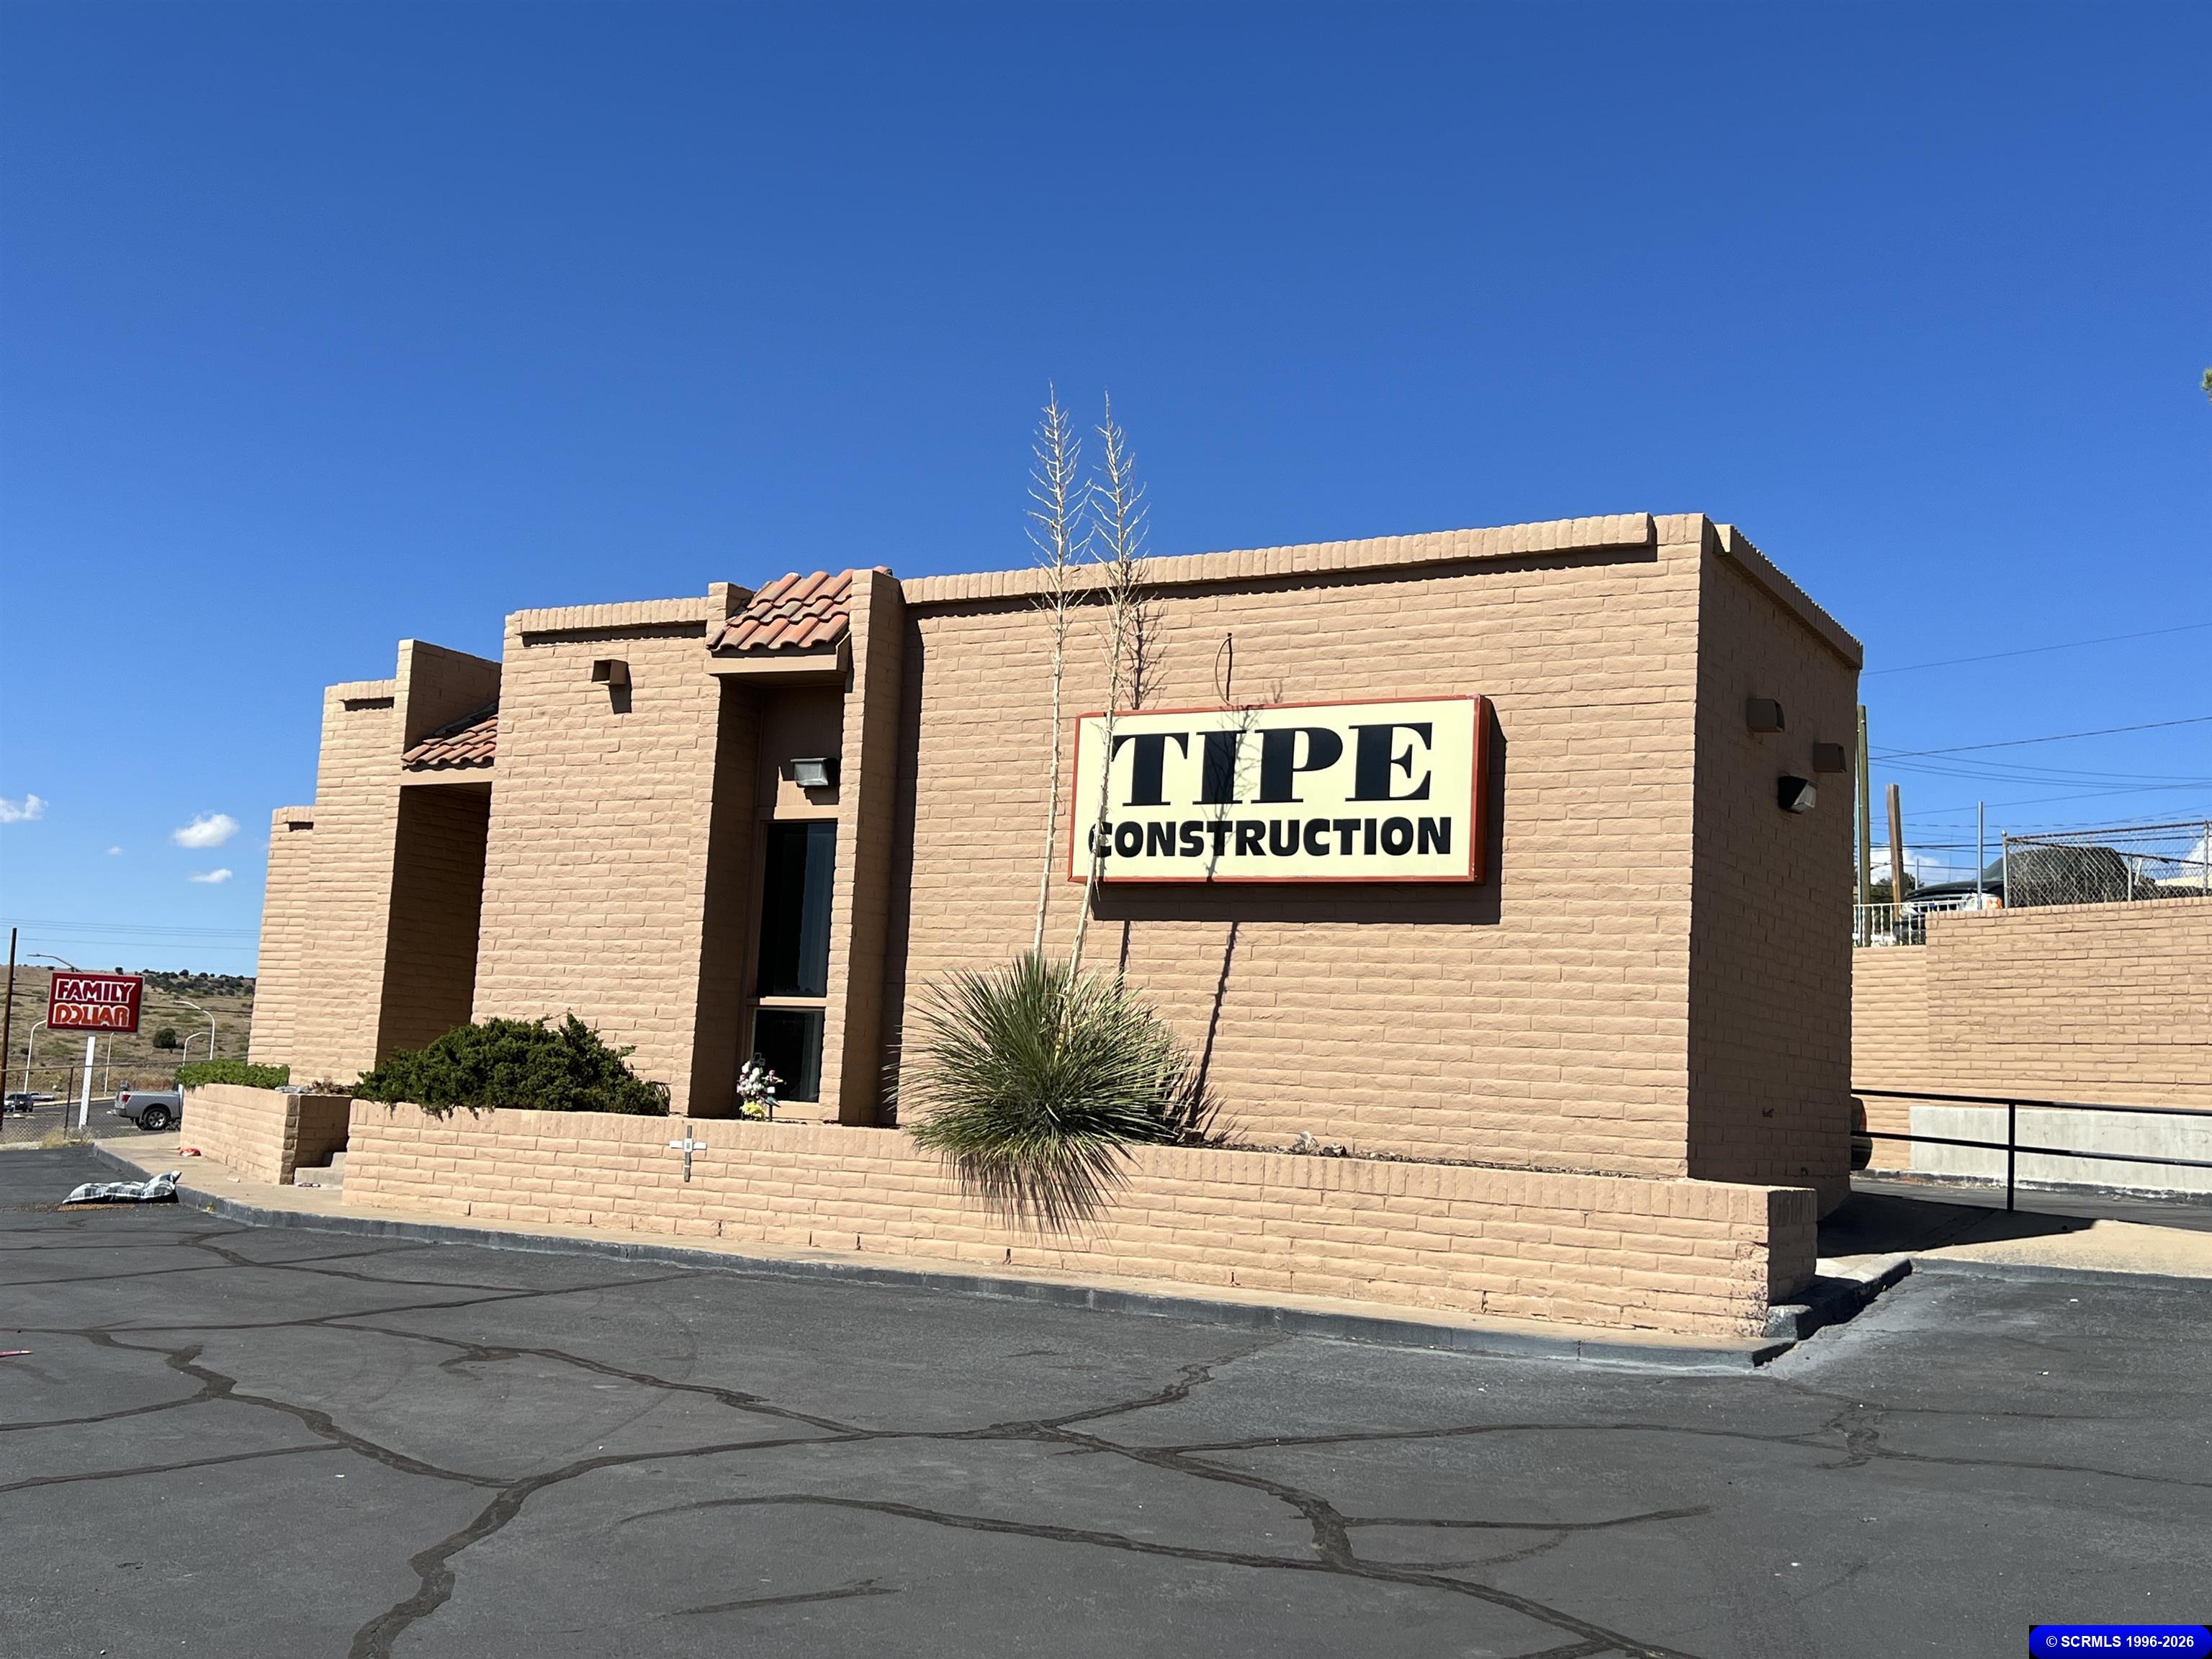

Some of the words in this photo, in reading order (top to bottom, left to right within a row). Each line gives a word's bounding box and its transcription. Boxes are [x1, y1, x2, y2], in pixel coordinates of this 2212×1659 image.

[1110, 721, 1433, 806] TIPE
[1088, 817, 1452, 858] CONSTRUCTION
[55, 979, 136, 1003] FAMILY
[53, 1003, 130, 1027] DOLLAR
